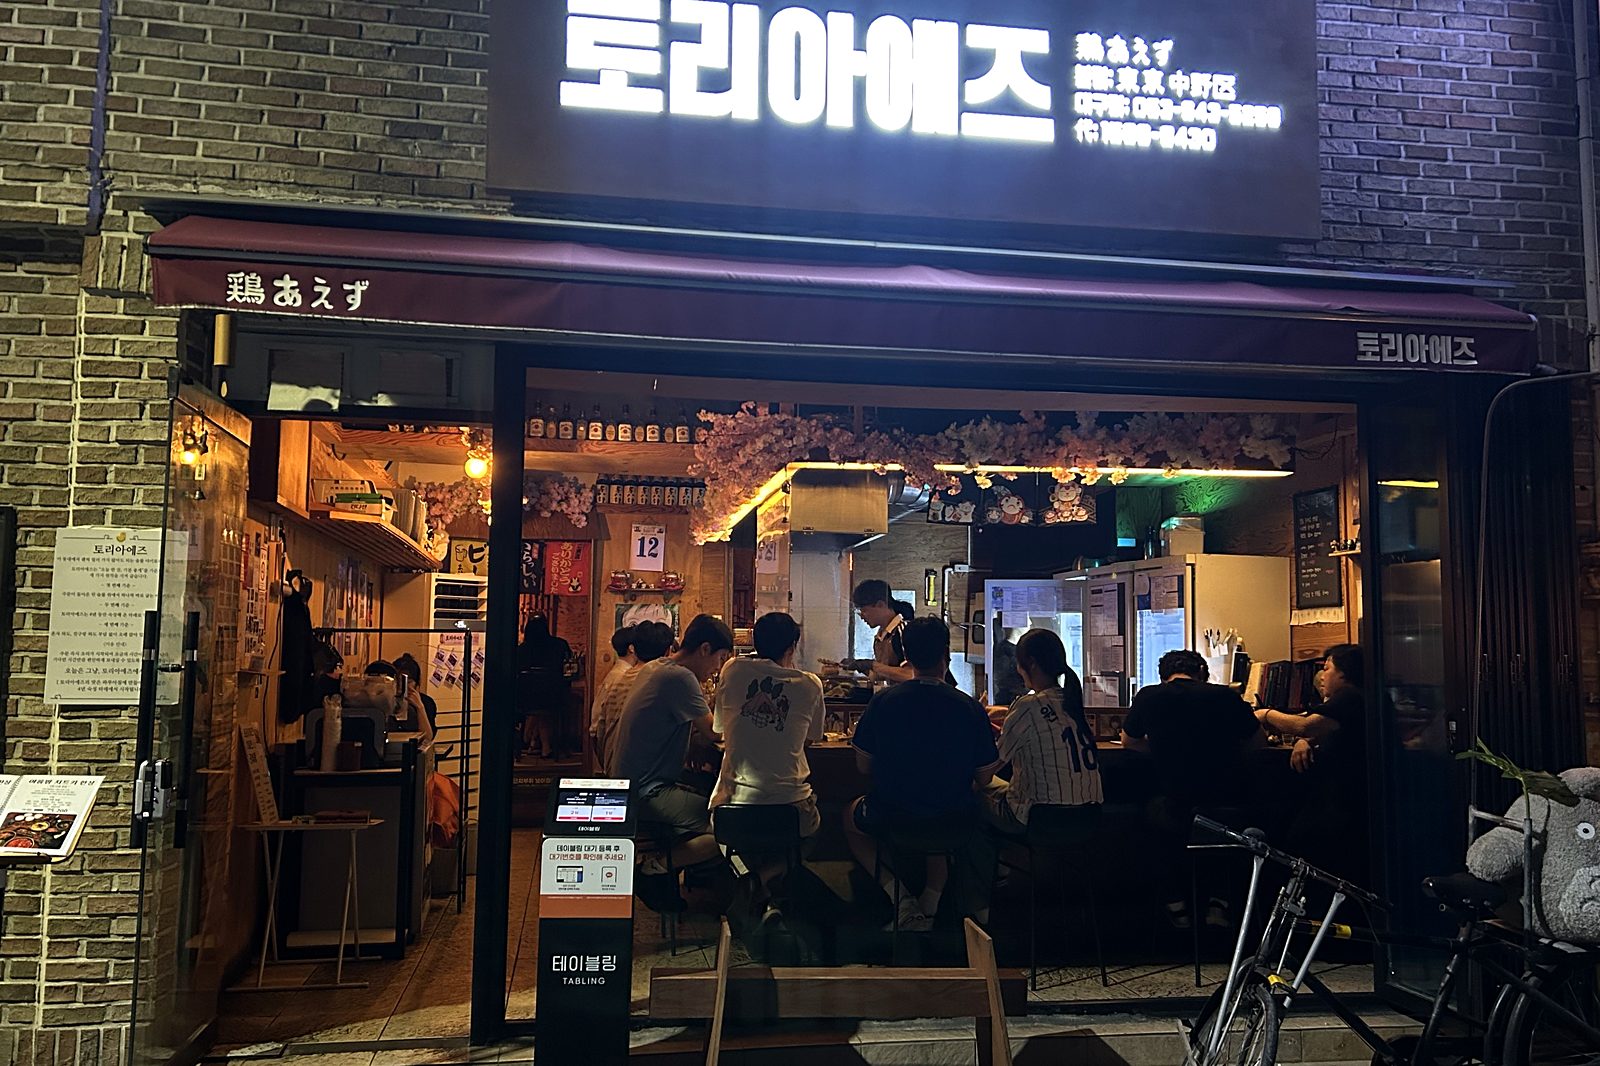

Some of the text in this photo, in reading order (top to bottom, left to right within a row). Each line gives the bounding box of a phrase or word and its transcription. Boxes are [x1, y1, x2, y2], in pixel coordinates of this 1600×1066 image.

[559, 0, 1056, 143] 토리아에즈
[226, 271, 370, 311] 鶏あえず
[1356, 331, 1479, 366] 토리아에즈
[93, 544, 148, 556] 토리아에즈
[636, 536, 659, 558] 12
[549, 853, 582, 861] 대기번호를
[556, 844, 582, 852] 테이블링
[584, 844, 597, 852] 대기
[613, 844, 621, 852] 후
[552, 954, 617, 972] 테이블링
[563, 977, 606, 985] TABLING
